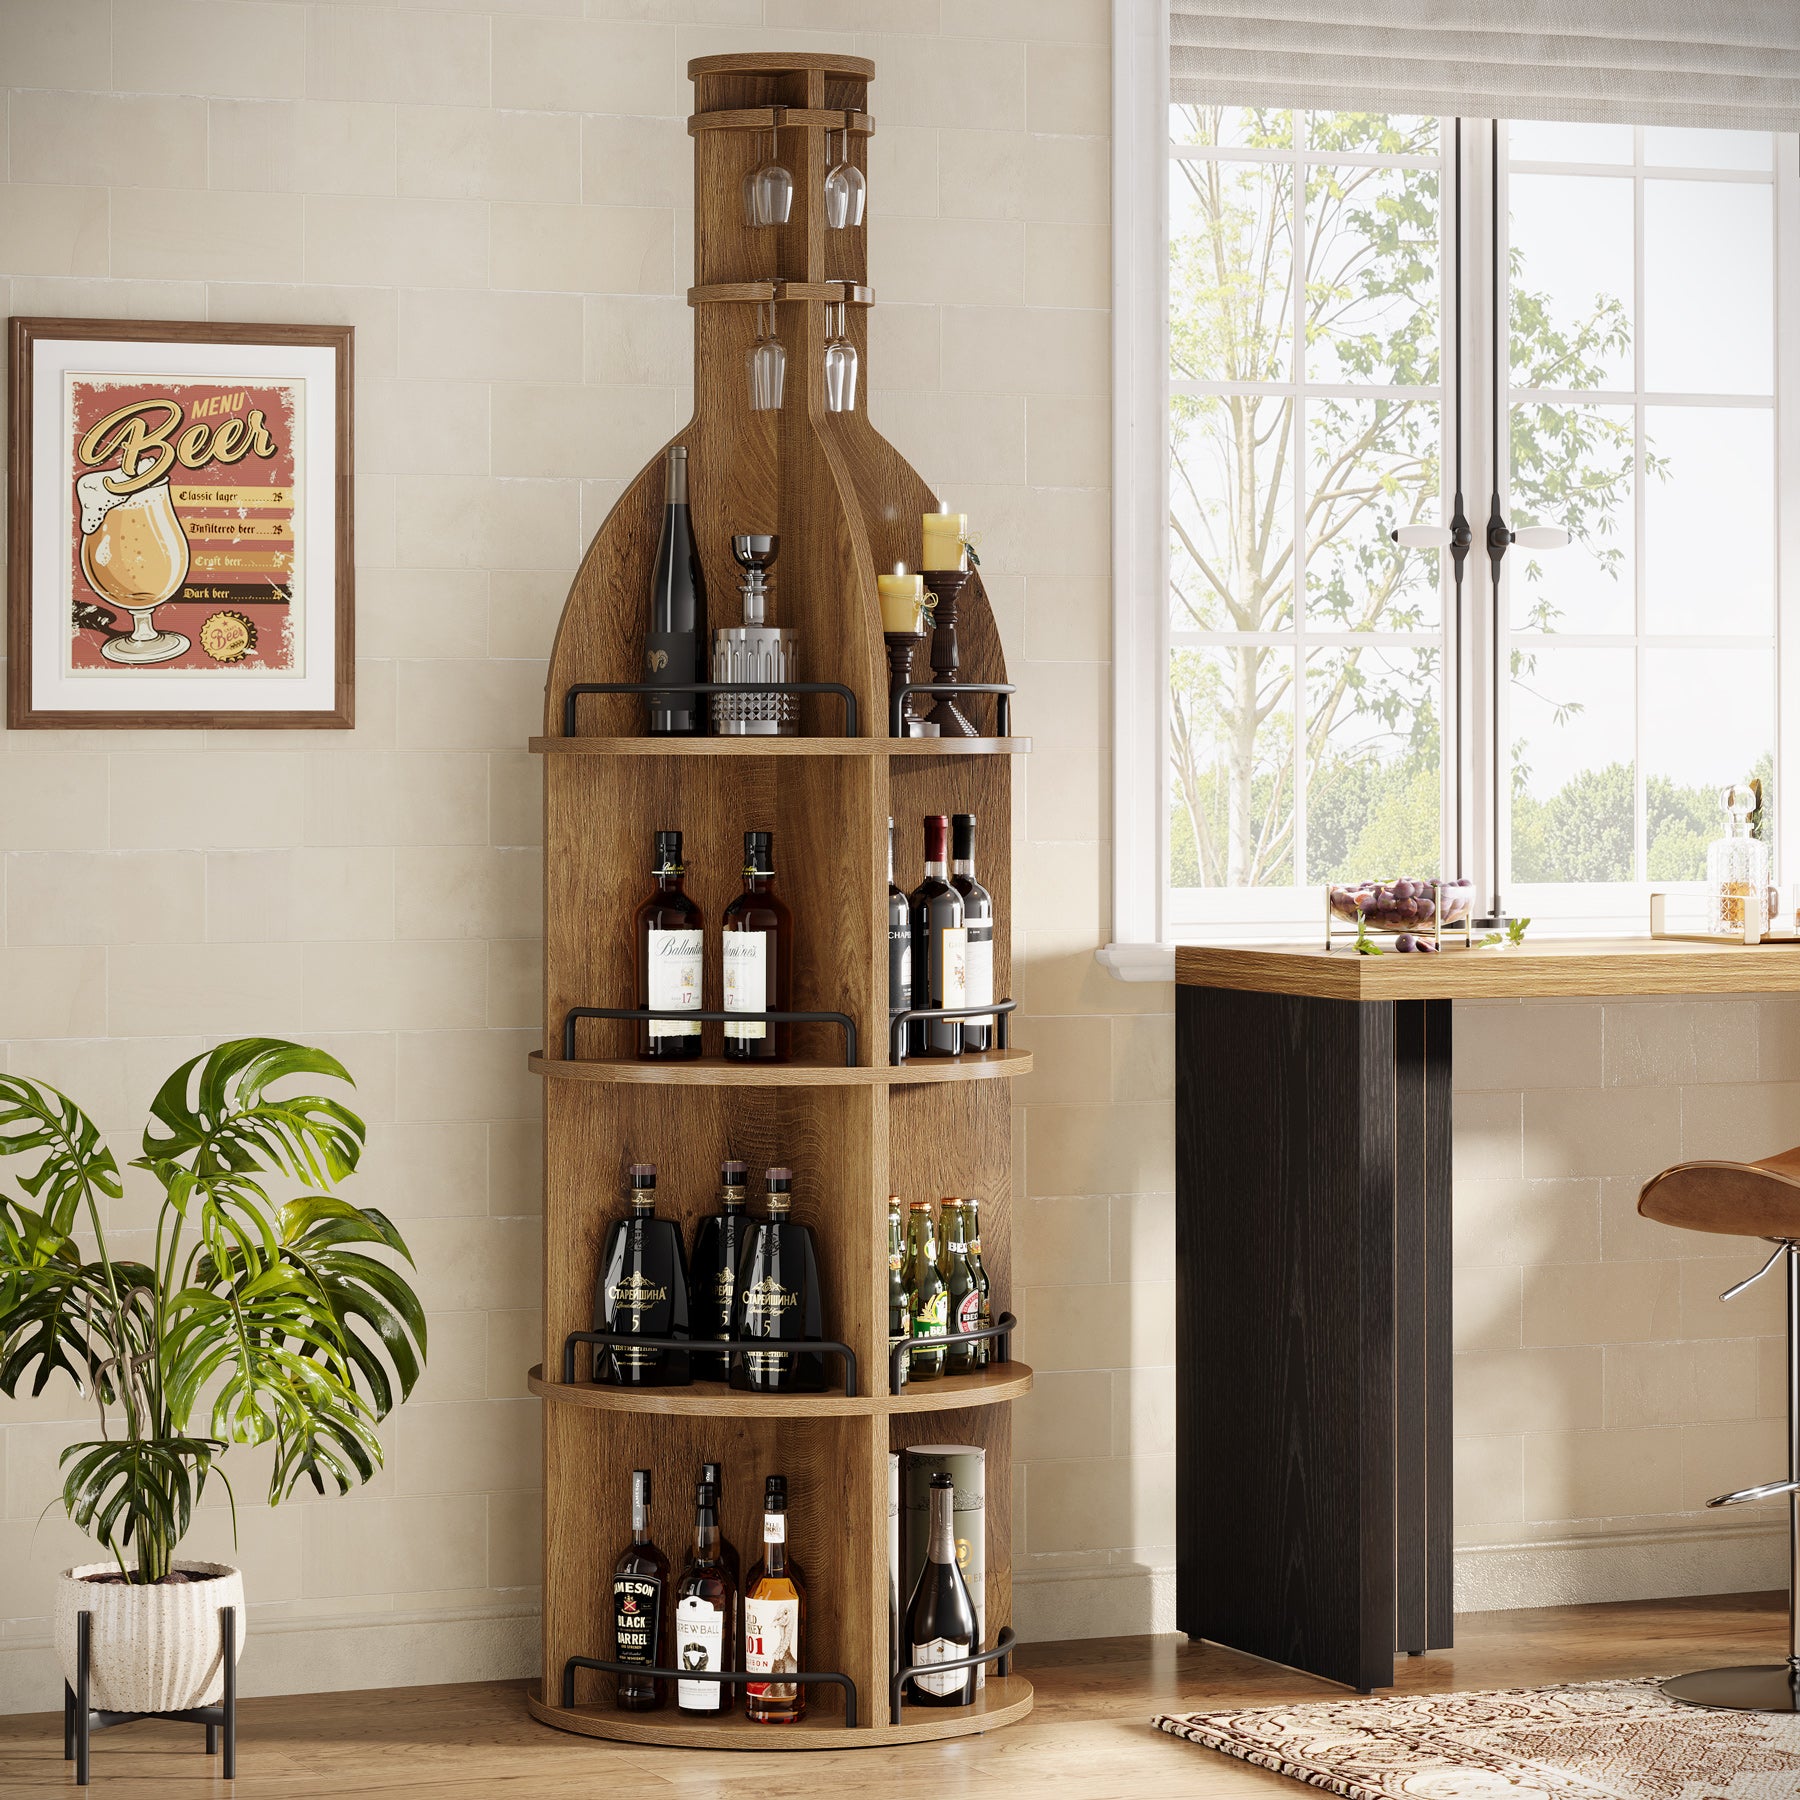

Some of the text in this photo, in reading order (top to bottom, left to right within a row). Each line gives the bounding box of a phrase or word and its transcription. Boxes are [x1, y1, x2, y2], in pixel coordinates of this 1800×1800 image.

[191, 392, 245, 420] MENU
[78, 399, 277, 495] Beer
[179, 491, 212, 501] Classic
[216, 491, 238, 502] lager
[239, 524, 255, 534] beer
[224, 556, 241, 566] beer
[183, 588, 210, 599] Dark
[212, 589, 230, 599] beer
[210, 626, 244, 651] Beer
[682, 992, 692, 1004] 17
[608, 1285, 667, 1300] СТАРЕЙШИНА
[742, 1290, 798, 1306] СТАРЕЙШИНА
[632, 1315, 640, 1332] 5
[721, 1311, 729, 1327] 5
[763, 1320, 771, 1337] 5
[617, 1615, 646, 1628] BLACK
[617, 1631, 648, 1645] BARREL
